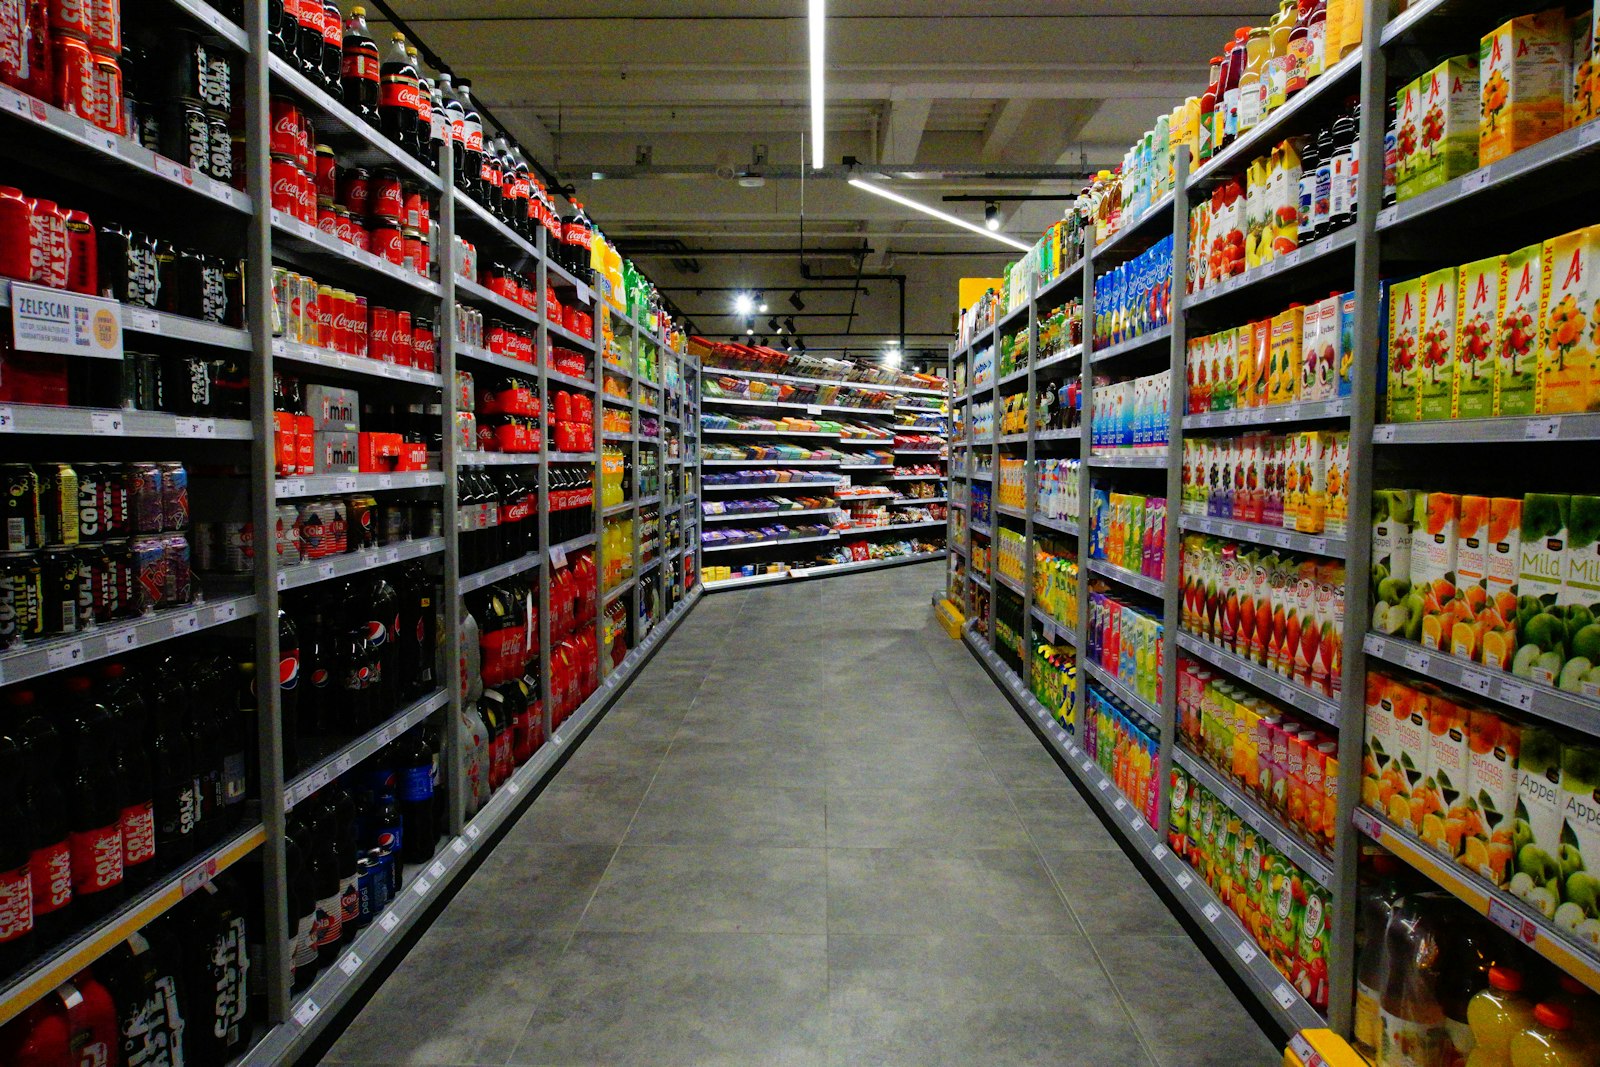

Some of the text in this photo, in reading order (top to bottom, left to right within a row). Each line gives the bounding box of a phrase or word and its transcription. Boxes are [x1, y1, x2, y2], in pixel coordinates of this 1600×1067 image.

[51, 217, 64, 288] TASTE
[20, 298, 70, 319] ZELFSCAN
[1539, 246, 1553, 353] VOORDEELPAK
[1456, 270, 1466, 362] VOORDEELPAK
[331, 403, 352, 421] mini
[333, 446, 356, 465] mini
[411, 444, 426, 463] mini
[80, 482, 98, 535] COLA
[1522, 552, 1560, 577] Mild
[27, 584, 37, 621] TASTE
[1520, 774, 1557, 805] Appel
[95, 837, 112, 887] COLA
[361, 886, 370, 915] pepsi
